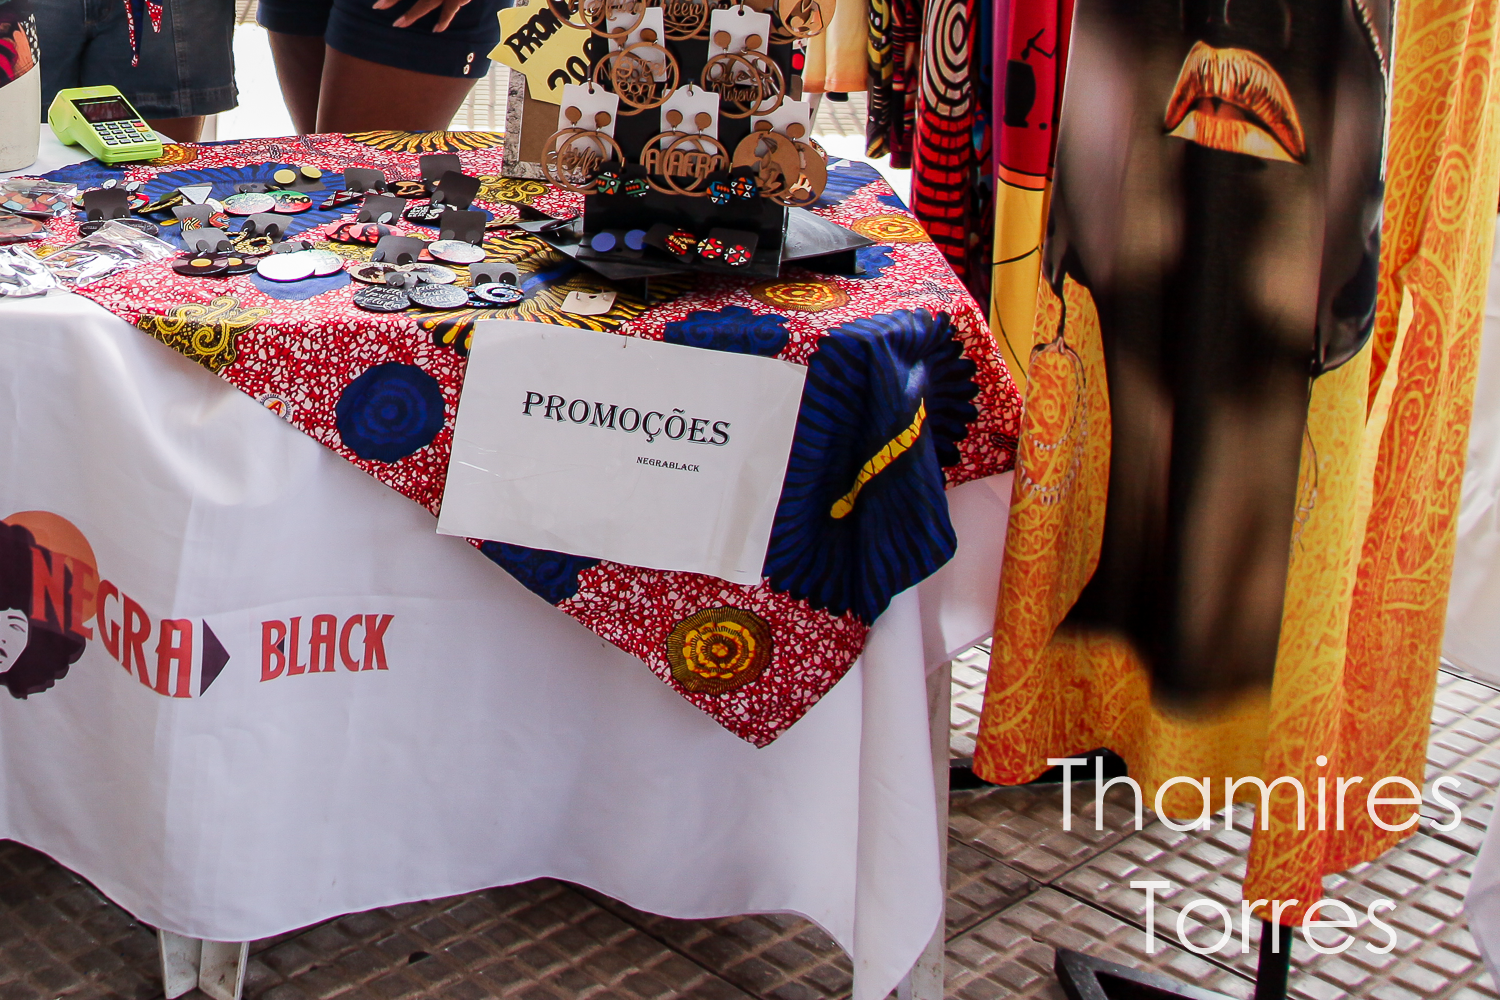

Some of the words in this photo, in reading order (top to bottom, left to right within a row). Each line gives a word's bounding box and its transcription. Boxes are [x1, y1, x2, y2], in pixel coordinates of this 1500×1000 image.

[522, 390, 732, 447] PROMOÇÕES
[636, 456, 701, 473] NEGRABLACK
[30, 544, 193, 699] NEGRA
[258, 613, 395, 684] BLACK
